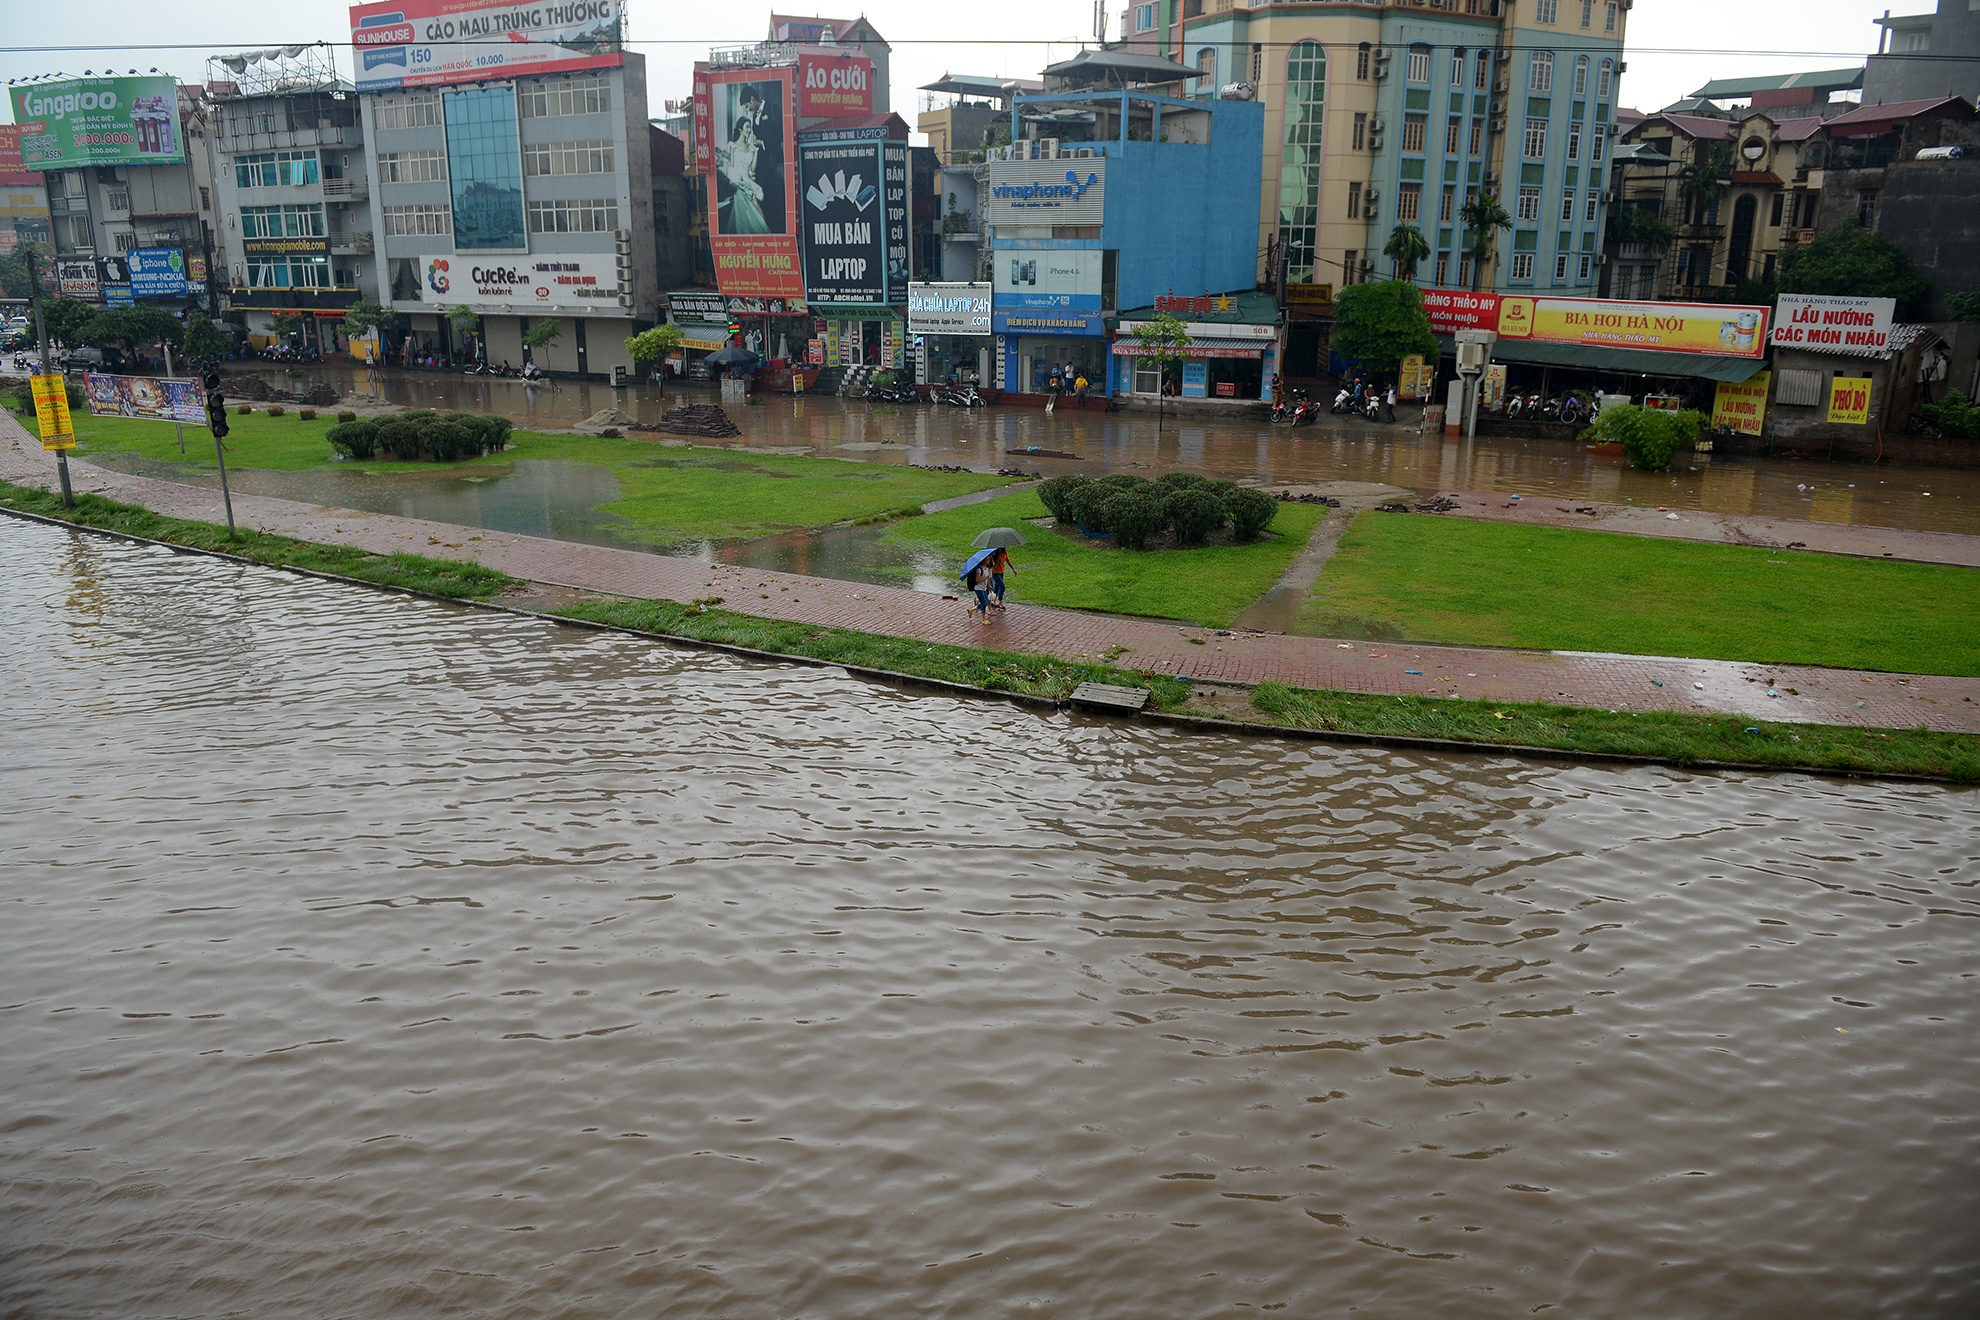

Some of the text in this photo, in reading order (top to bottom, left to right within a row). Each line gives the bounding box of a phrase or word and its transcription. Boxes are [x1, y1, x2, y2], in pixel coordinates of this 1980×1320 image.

[426, 19, 454, 41] CÀO
[460, 17, 490, 36] MAU
[496, 6, 542, 32] TRÚNG
[356, 28, 410, 44] SUNHOUSE
[410, 49, 432, 64] 150
[476, 54, 504, 66] 10.000
[84, 79, 97, 87] Việt
[806, 62, 866, 90] ÁO CƯỚI
[18, 92, 117, 120] Kangaroo
[856, 129, 886, 138] LAPTOP
[992, 182, 1072, 200] vinaphone
[885, 148, 906, 259] MUA BÁN LAP TOP CŨ MỚI
[814, 218, 871, 245] MUA BÁN
[246, 240, 326, 253] www.hoanggiamobile.com
[143, 258, 167, 268] iphone
[720, 249, 760, 269] NGUYỄN
[821, 258, 866, 280] LAPTOP
[944, 297, 972, 312] LAPTOP
[972, 298, 990, 313] 24h
[1157, 288, 1212, 313] CẦM ĐỒ
[1424, 293, 1495, 310] HÀNG THẢO MY
[970, 316, 990, 326] .com
[1022, 318, 1036, 328] DỊCH
[1038, 319, 1046, 328] VỤ
[1047, 316, 1068, 328] KHÁCH
[1431, 311, 1479, 324] MÓN NHẬU
[1565, 312, 1685, 334] BIA HƠI HÀ NỘI
[1791, 304, 1875, 326] LẨU NƯỚNG
[1253, 326, 1262, 334] SỐ
[1582, 330, 1662, 343] NHÀ HÀNG THẢO MY
[1774, 325, 1886, 348] CÁC MÓN NHẬU
[1719, 385, 1730, 393] BIA
[1753, 388, 1765, 400] NỘI
[1832, 382, 1866, 411] PHỞ BÒ
[1722, 397, 1756, 414] LẨU NƯỚNG
[1743, 418, 1760, 433] NHẬU
